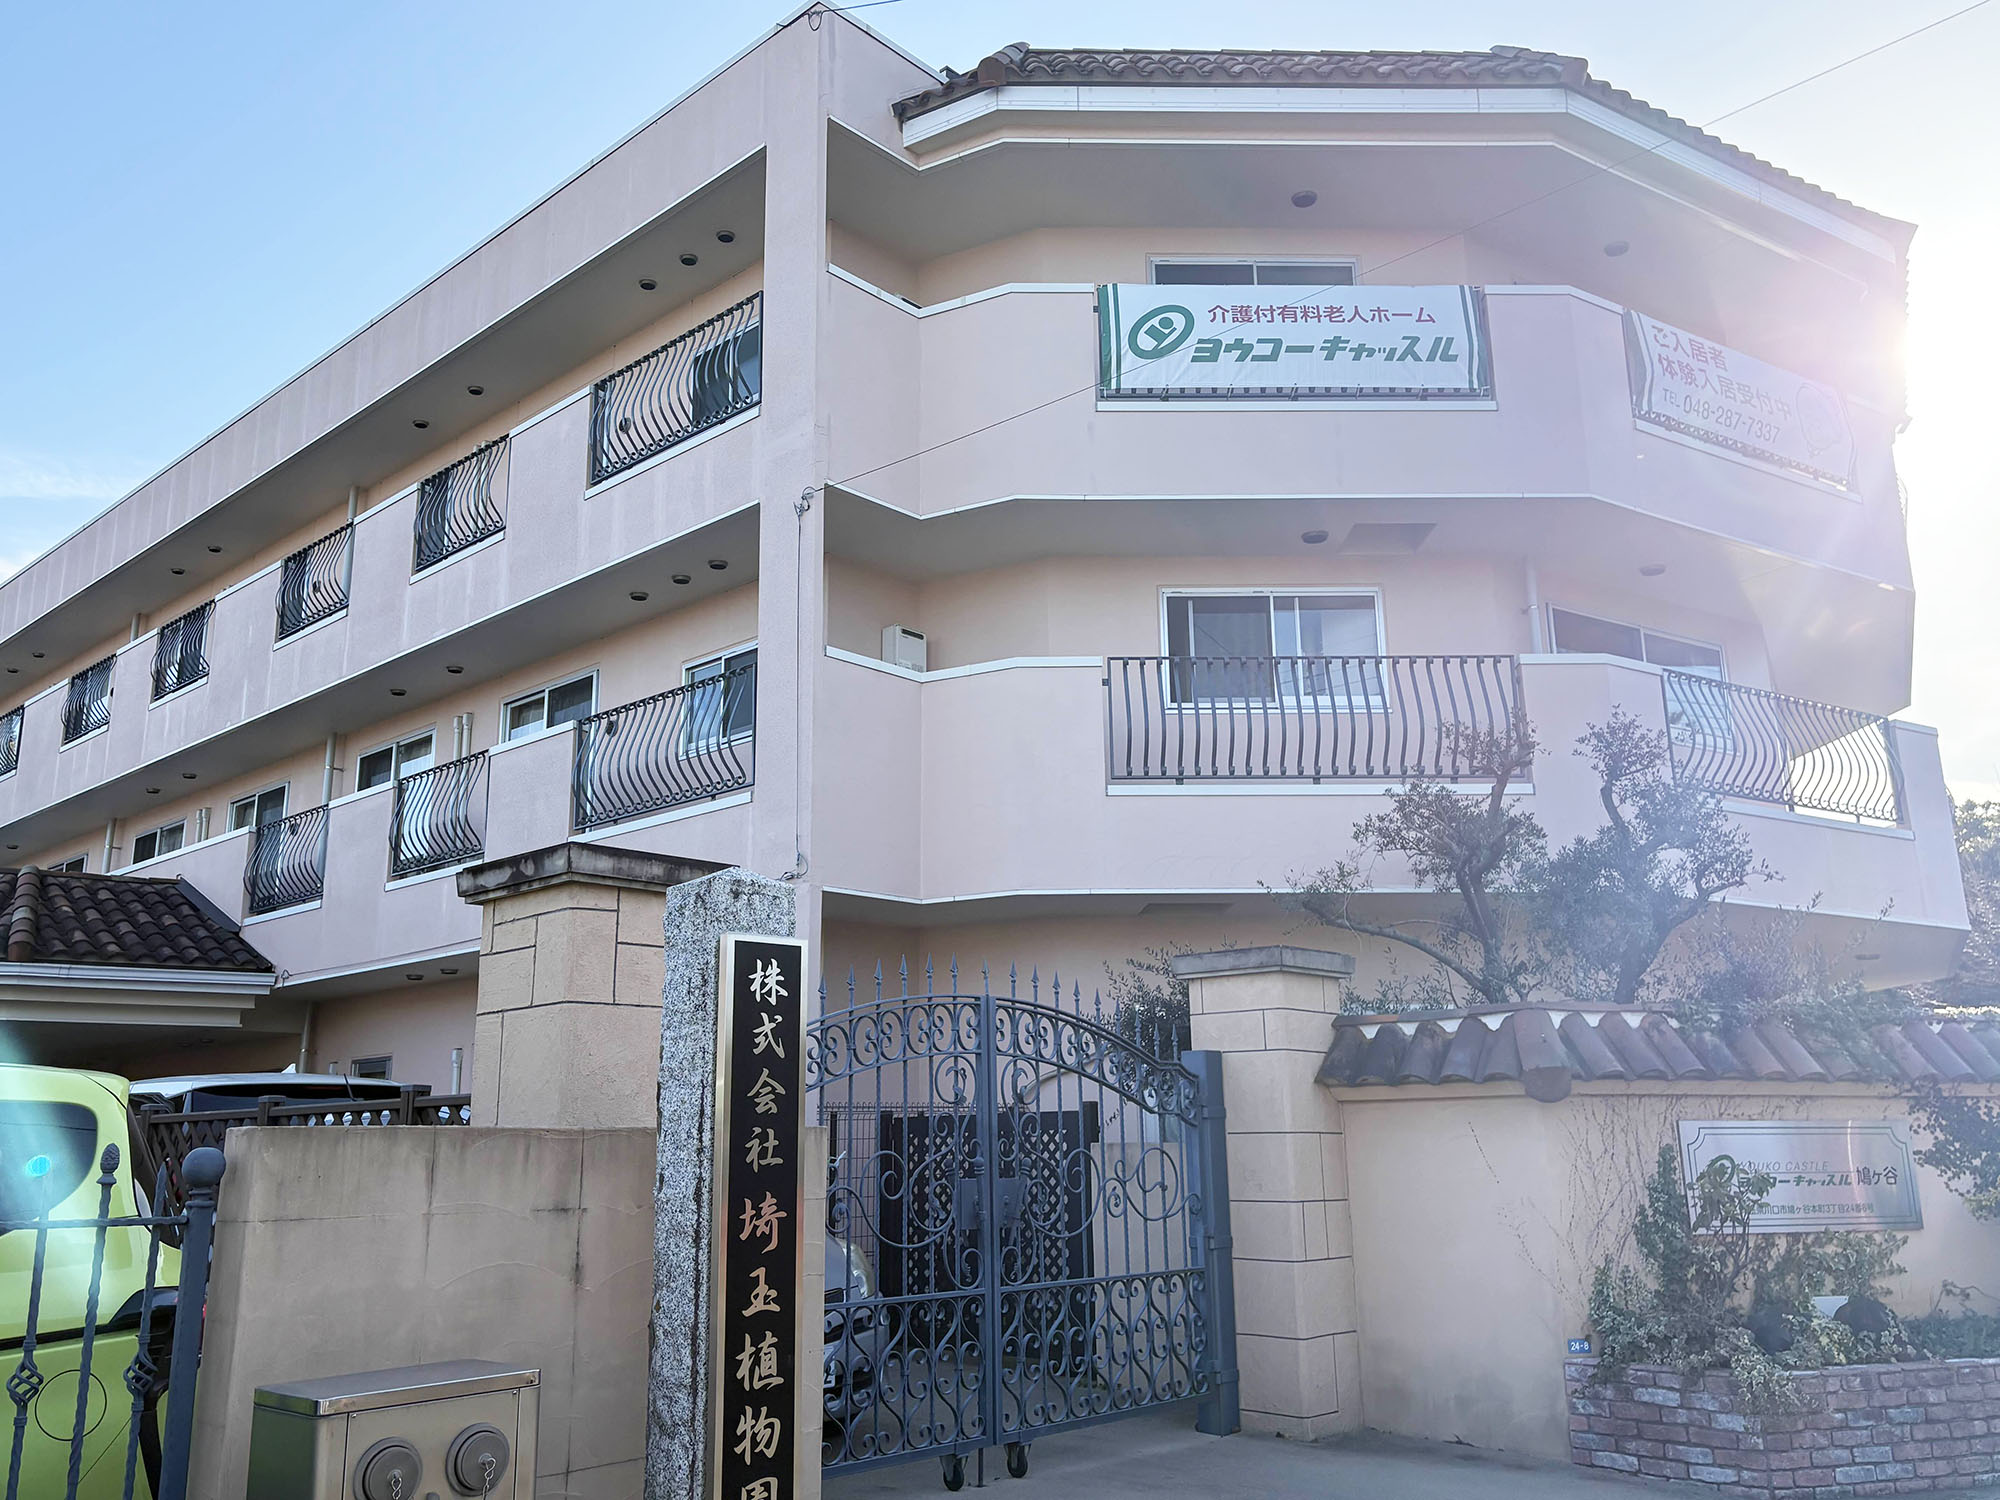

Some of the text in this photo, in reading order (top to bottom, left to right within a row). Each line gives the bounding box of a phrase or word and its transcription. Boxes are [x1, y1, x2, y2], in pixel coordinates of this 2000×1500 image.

[1207, 304, 1436, 324] 介護付有料老人ホーム
[1190, 335, 1459, 363] ヨウコーキャッスル
[1651, 325, 1728, 372] ご入居者
[1658, 353, 1793, 421] 体験入居受付中
[1662, 387, 1781, 444] TEL 048-287-7337
[1785, 1160, 1829, 1171] CASTLE
